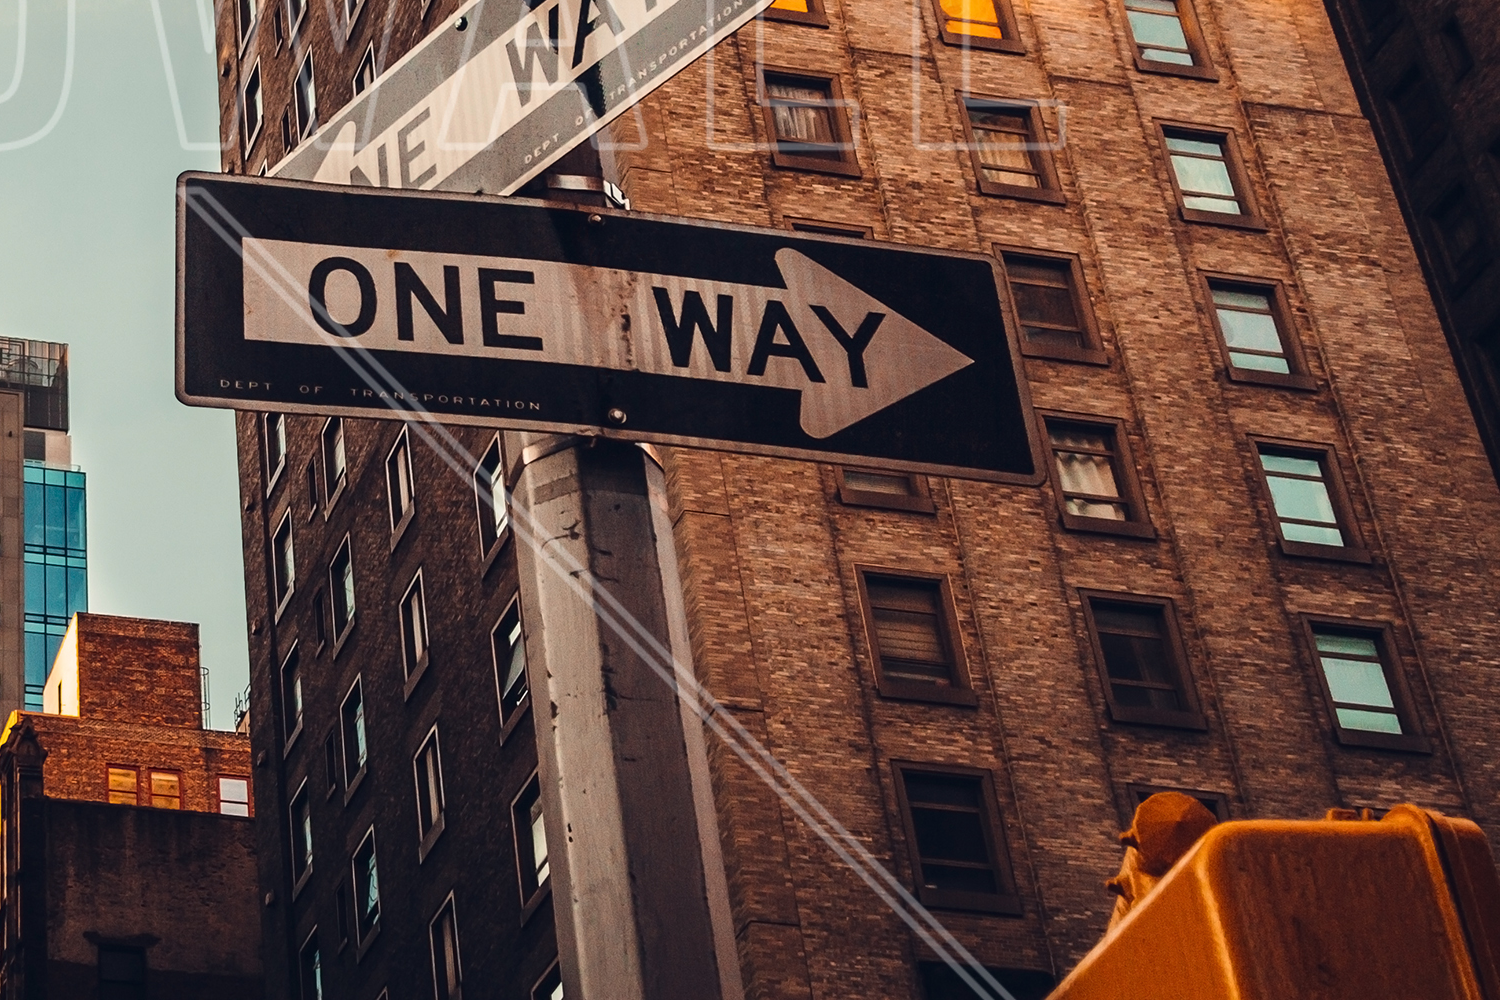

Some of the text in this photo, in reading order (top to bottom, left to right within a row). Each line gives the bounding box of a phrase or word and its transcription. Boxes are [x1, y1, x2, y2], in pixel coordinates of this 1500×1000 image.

[524, 133, 560, 164] DEPT
[308, 255, 887, 389] ONE WAY
[220, 378, 541, 411] DEPT OF TRANSPORTATION
